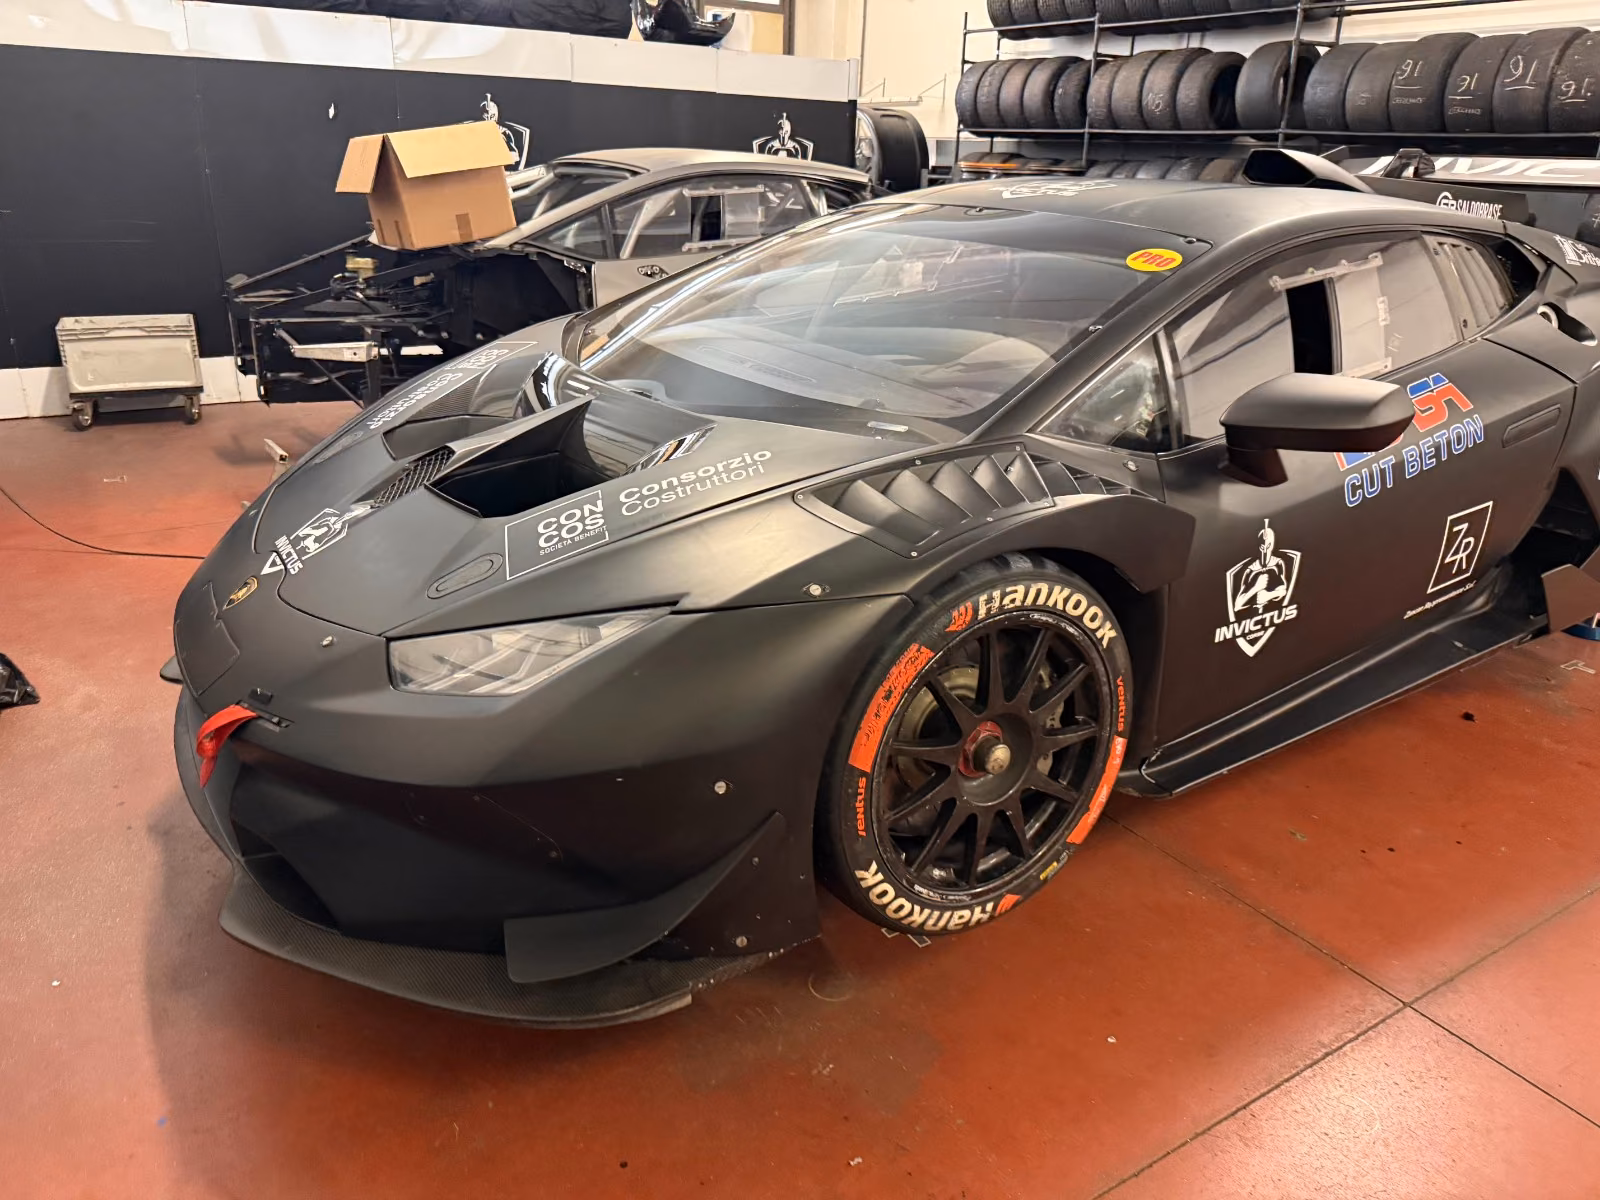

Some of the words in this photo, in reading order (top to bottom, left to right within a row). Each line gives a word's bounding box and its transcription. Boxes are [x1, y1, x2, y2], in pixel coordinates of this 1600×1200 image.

[1131, 252, 1177, 268] PRO
[619, 450, 772, 503] Consorzio
[1344, 455, 1396, 507] CUT
[1402, 414, 1484, 479] BETON
[621, 462, 765, 516] Costruttori
[537, 498, 604, 534] CON
[538, 513, 605, 548] COS
[274, 535, 304, 575] INVICTUS
[1214, 604, 1298, 643] INVICTUS
